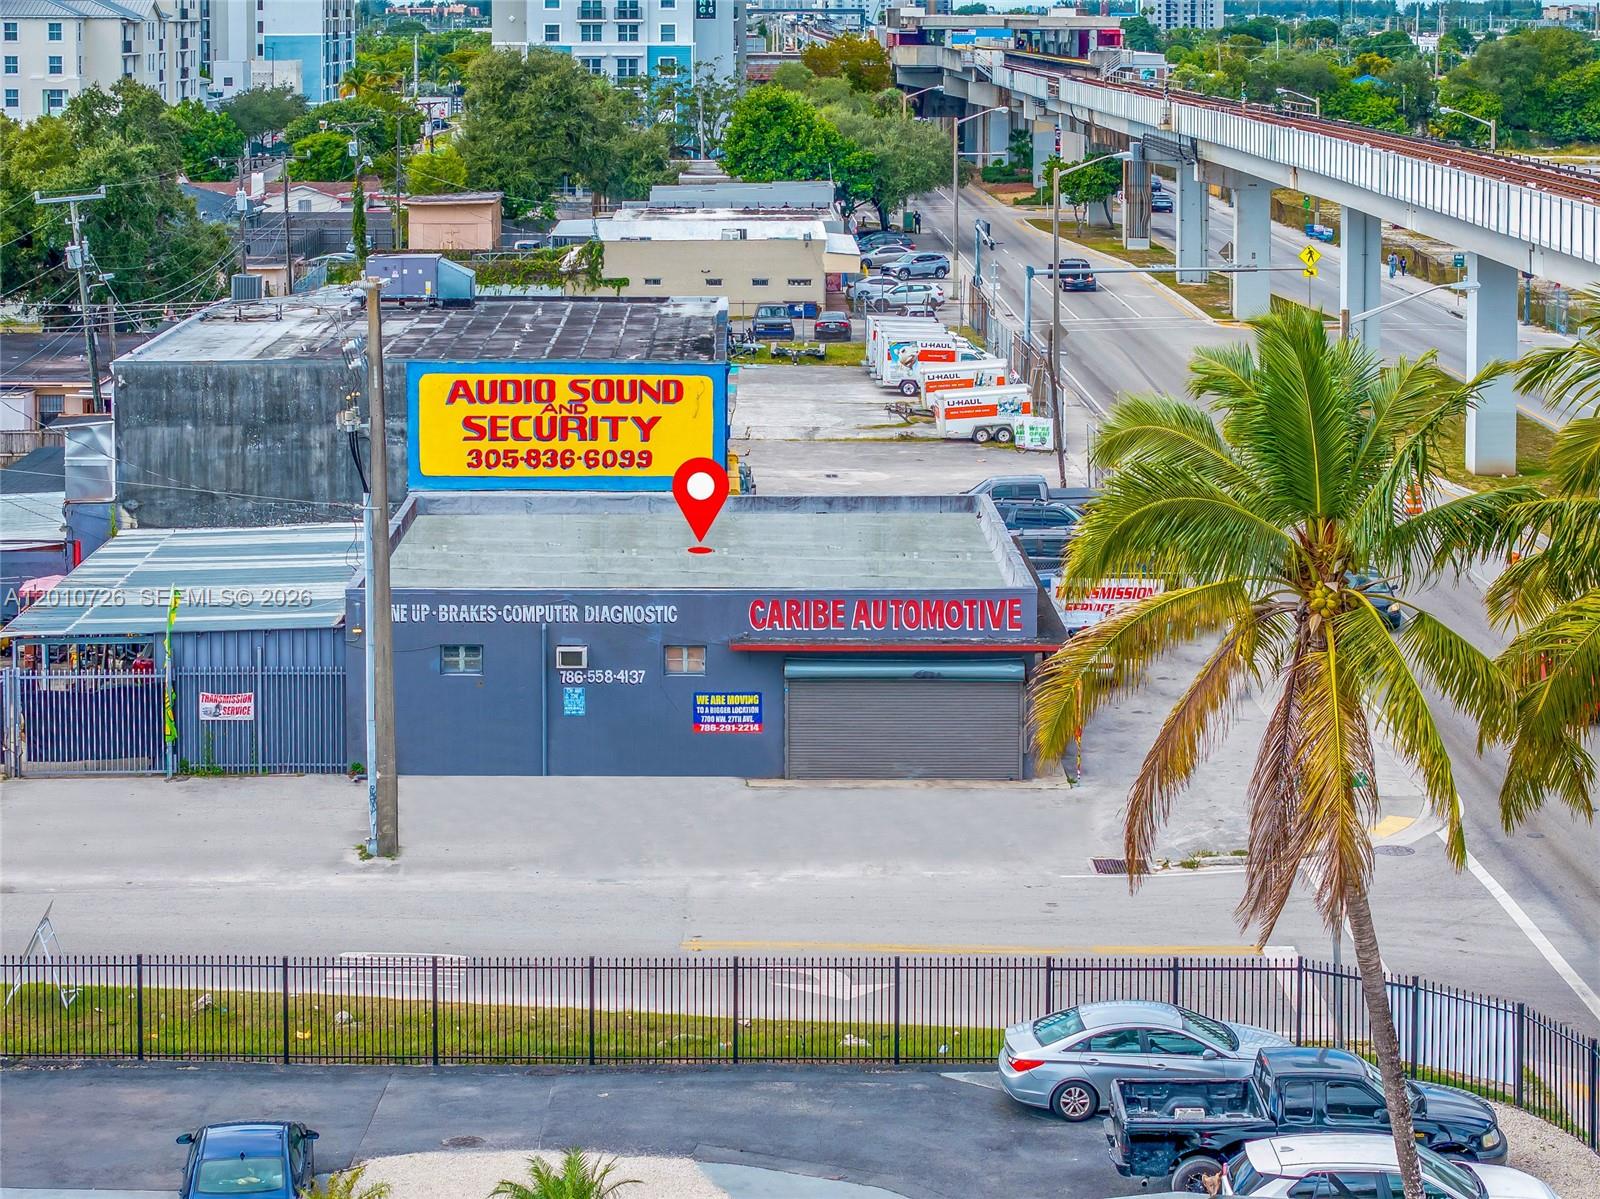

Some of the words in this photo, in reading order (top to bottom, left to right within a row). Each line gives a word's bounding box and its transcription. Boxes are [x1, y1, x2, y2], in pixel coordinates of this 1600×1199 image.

[927, 373, 961, 381] U-HAUL
[445, 379, 556, 405] AUDIO
[567, 379, 684, 405] SOUND
[947, 398, 982, 407] U-HAUL
[540, 404, 589, 415] AND
[462, 416, 663, 442] SECURITY
[584, 605, 678, 624] DIAGNOSTIC
[749, 599, 845, 631] CARIBE
[852, 599, 1023, 632] AUTOMOTIVE
[201, 694, 252, 703] TRANSMISSION
[696, 695, 709, 705] WE
[710, 695, 726, 705] ARE
[727, 695, 759, 705] MOVING
[222, 706, 251, 716] SERVICE
[696, 706, 704, 714] TO
[705, 706, 710, 714] A
[732, 706, 759, 714] LOCATION
[700, 724, 759, 732] 786-291-2214
